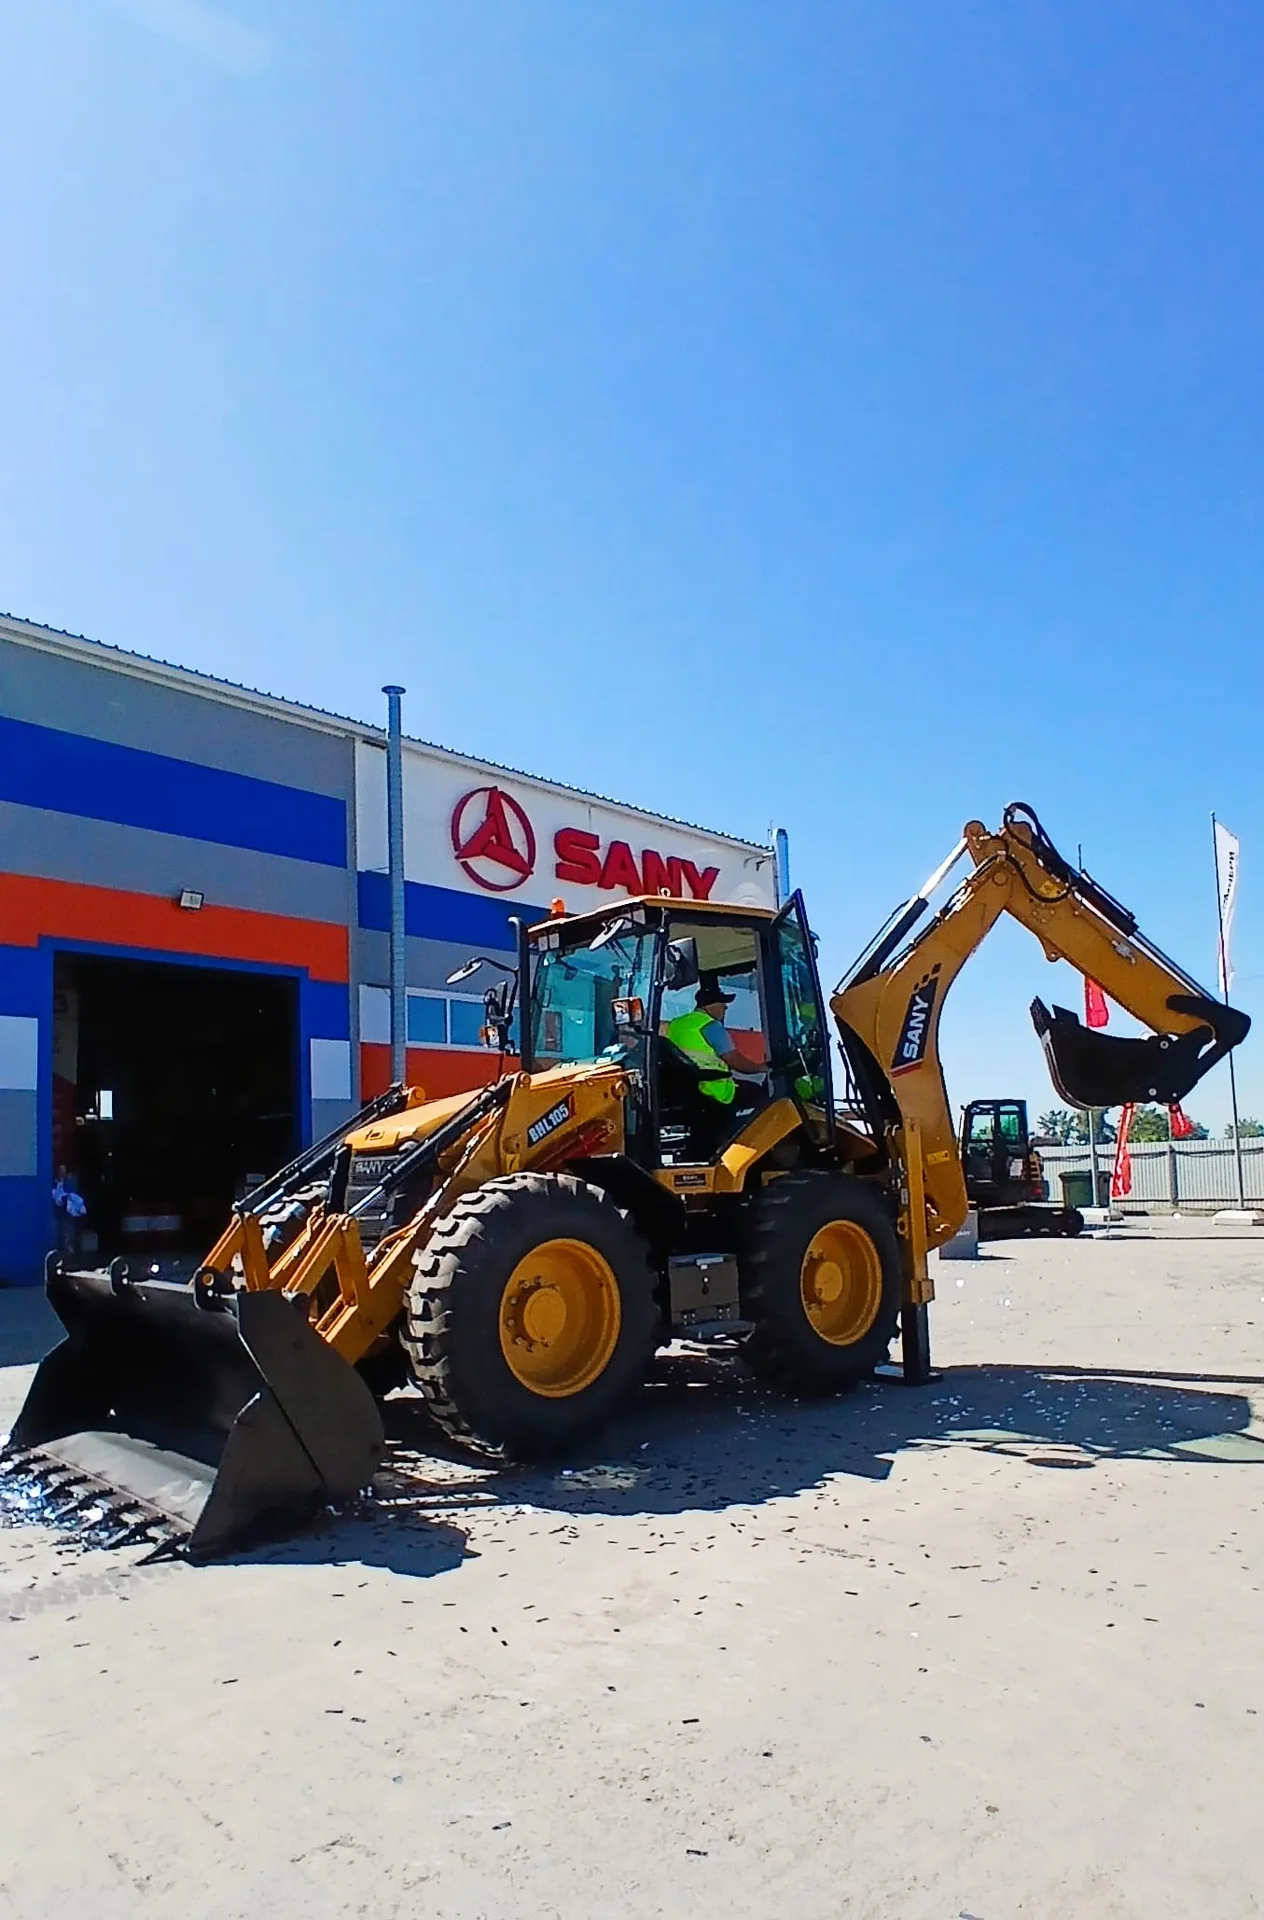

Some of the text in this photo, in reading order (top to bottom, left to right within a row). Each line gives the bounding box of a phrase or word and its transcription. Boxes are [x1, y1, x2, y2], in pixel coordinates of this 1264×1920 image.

[554, 827, 720, 900] SANY
[903, 995, 929, 1059] SANY
[529, 1103, 569, 1142] BHL105
